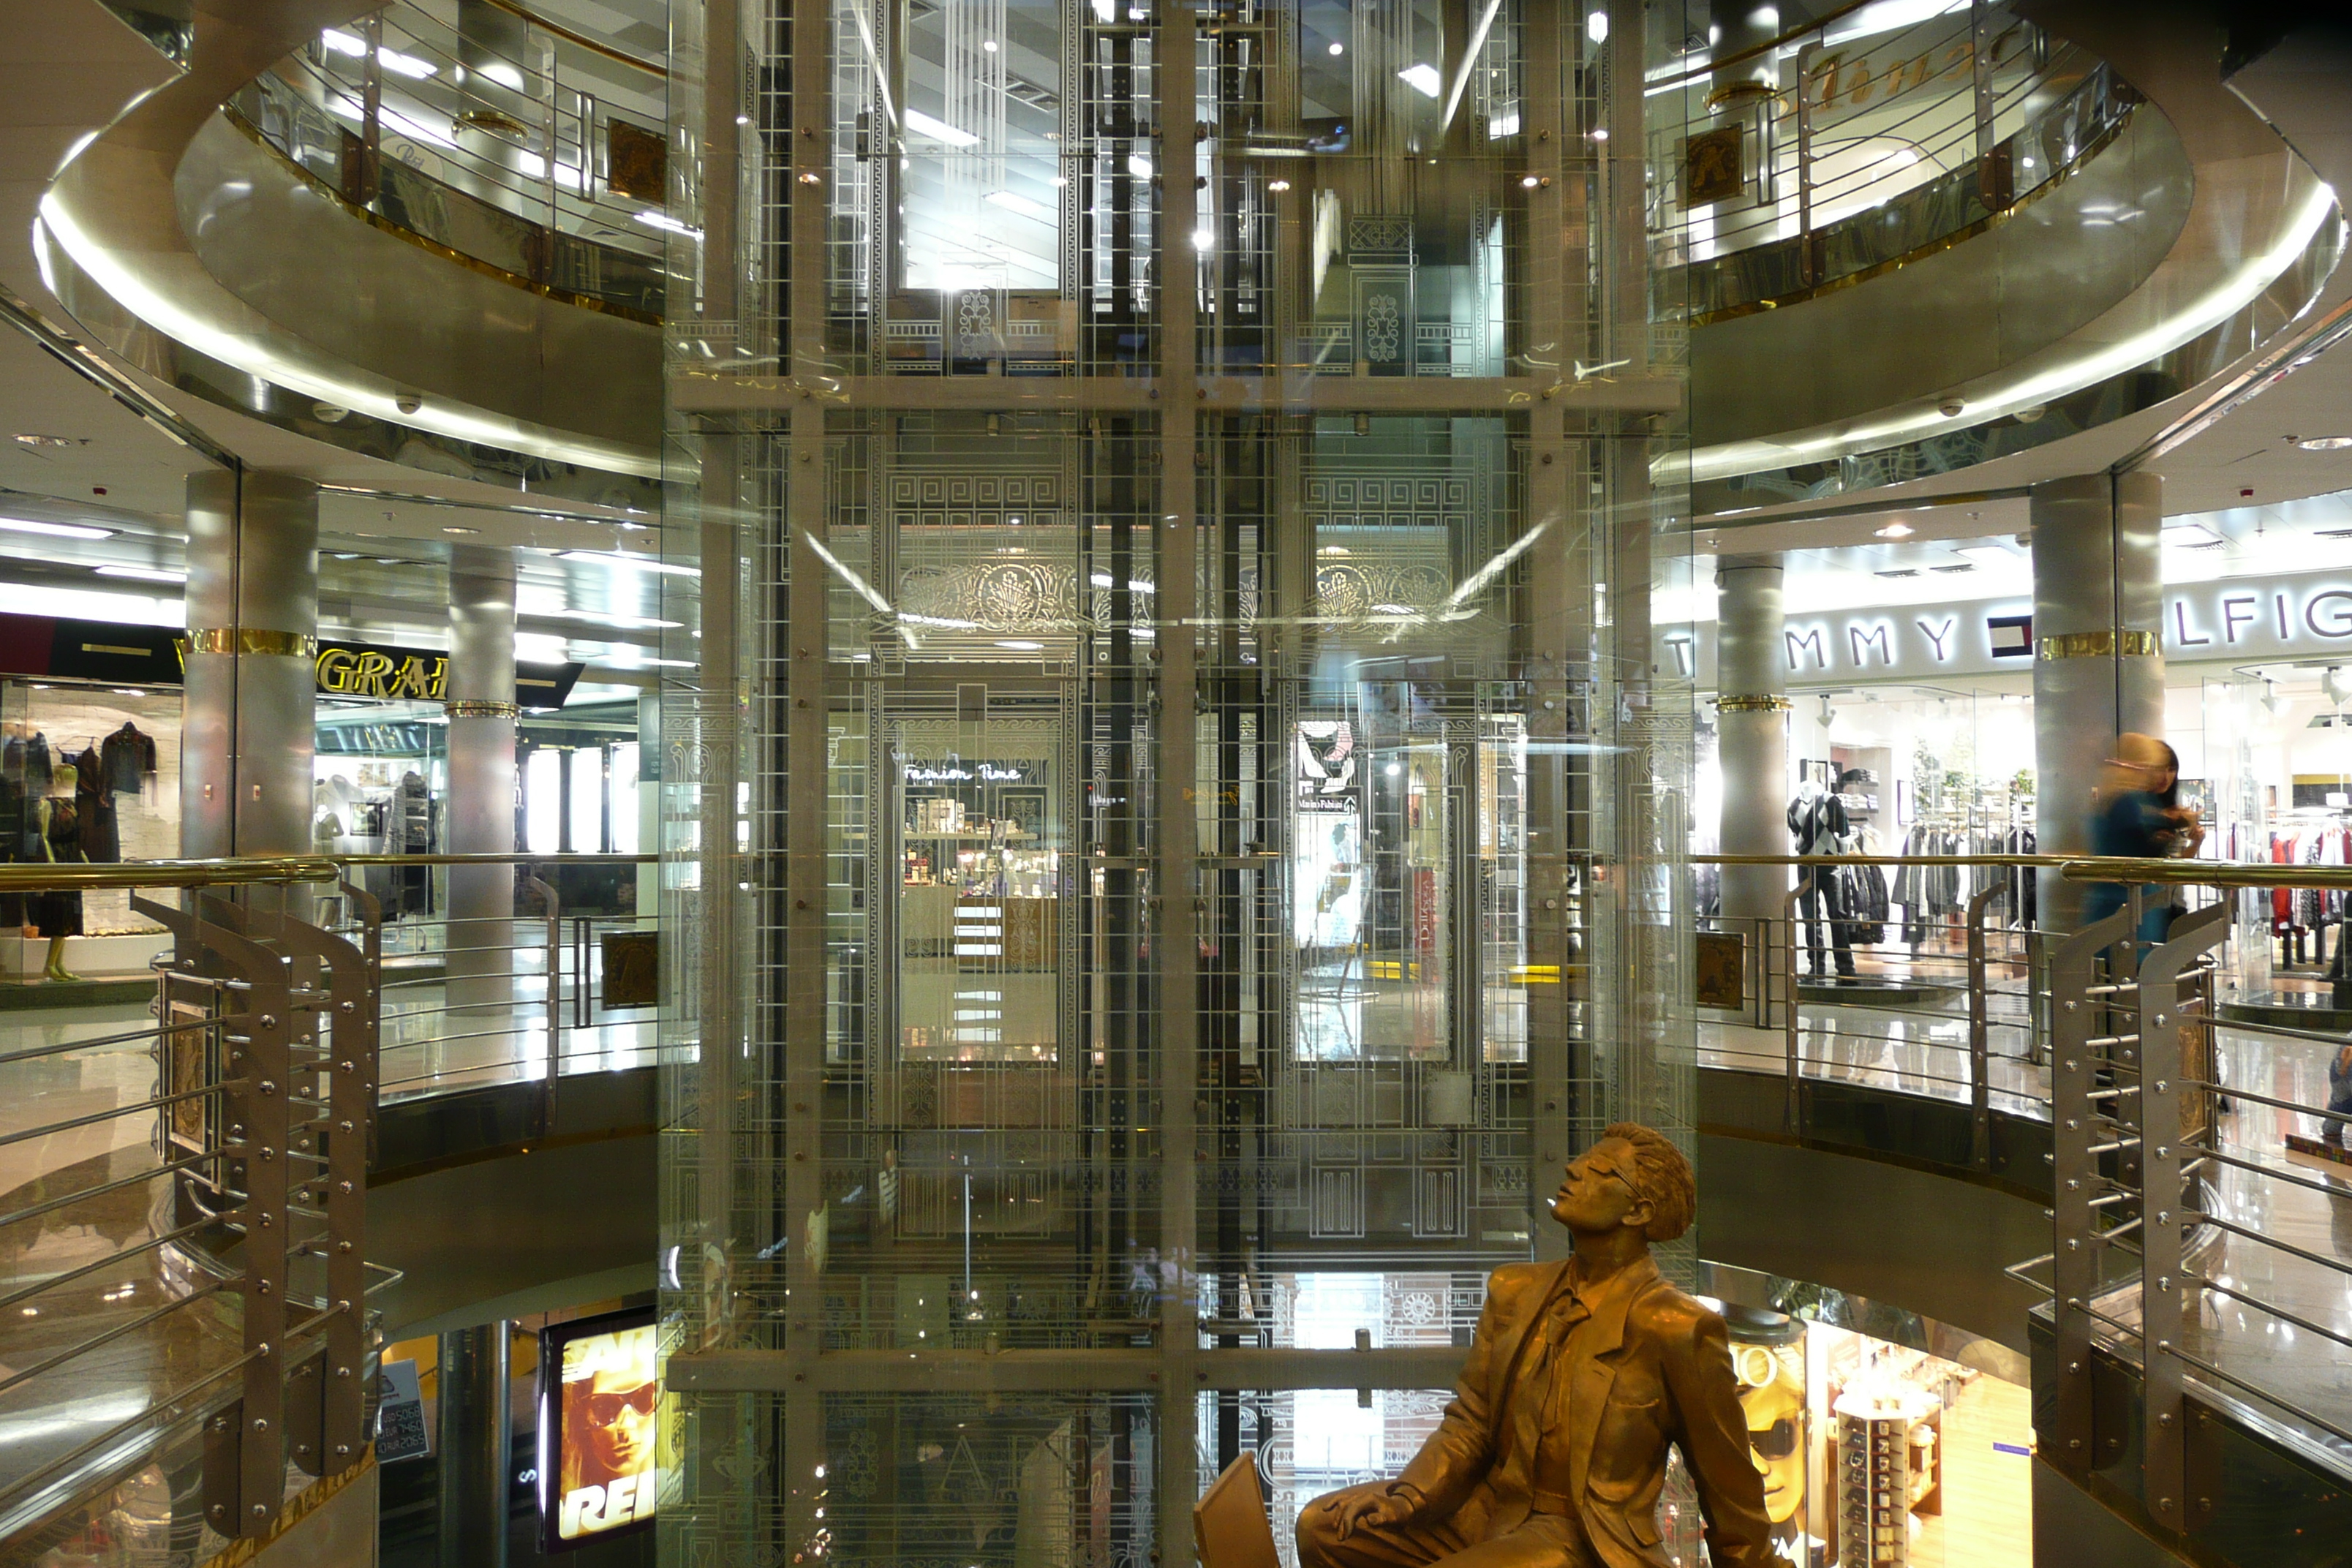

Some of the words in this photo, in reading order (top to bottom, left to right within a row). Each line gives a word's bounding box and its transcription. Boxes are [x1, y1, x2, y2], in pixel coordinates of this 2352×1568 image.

[2176, 590, 2352, 645] LFIG
[1664, 619, 1953, 675] TMMY
[904, 764, 973, 780] Fashion
[978, 763, 1022, 780] Time
